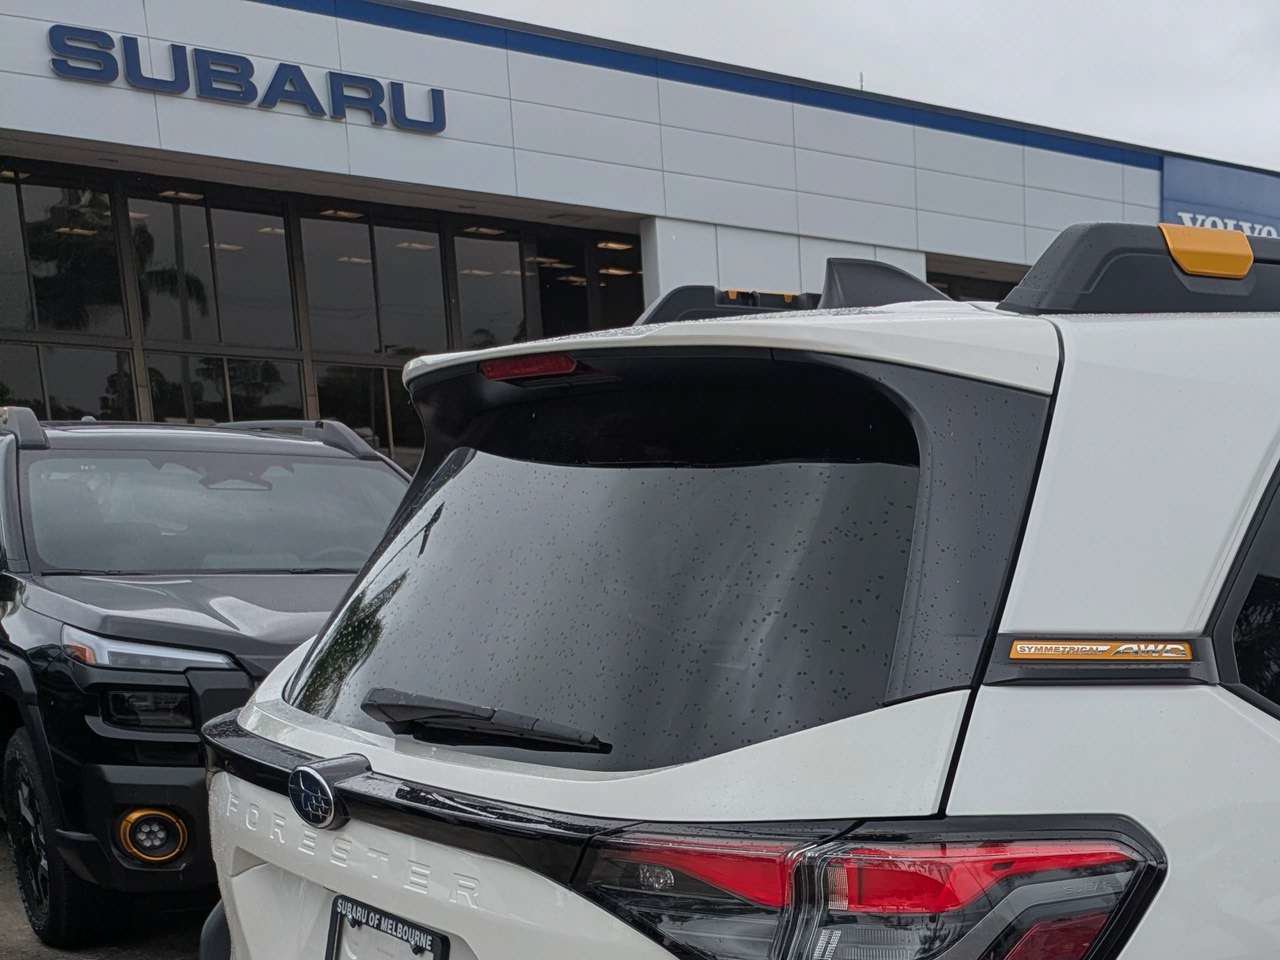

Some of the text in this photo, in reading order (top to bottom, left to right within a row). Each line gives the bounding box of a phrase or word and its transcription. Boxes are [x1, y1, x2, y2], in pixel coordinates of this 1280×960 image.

[48, 23, 447, 134] SUBARU
[1016, 643, 1187, 657] SYMMETRICAL AWD
[226, 790, 480, 910] FORESTER
[336, 898, 433, 951] SUBARU OF MELBOURNE
